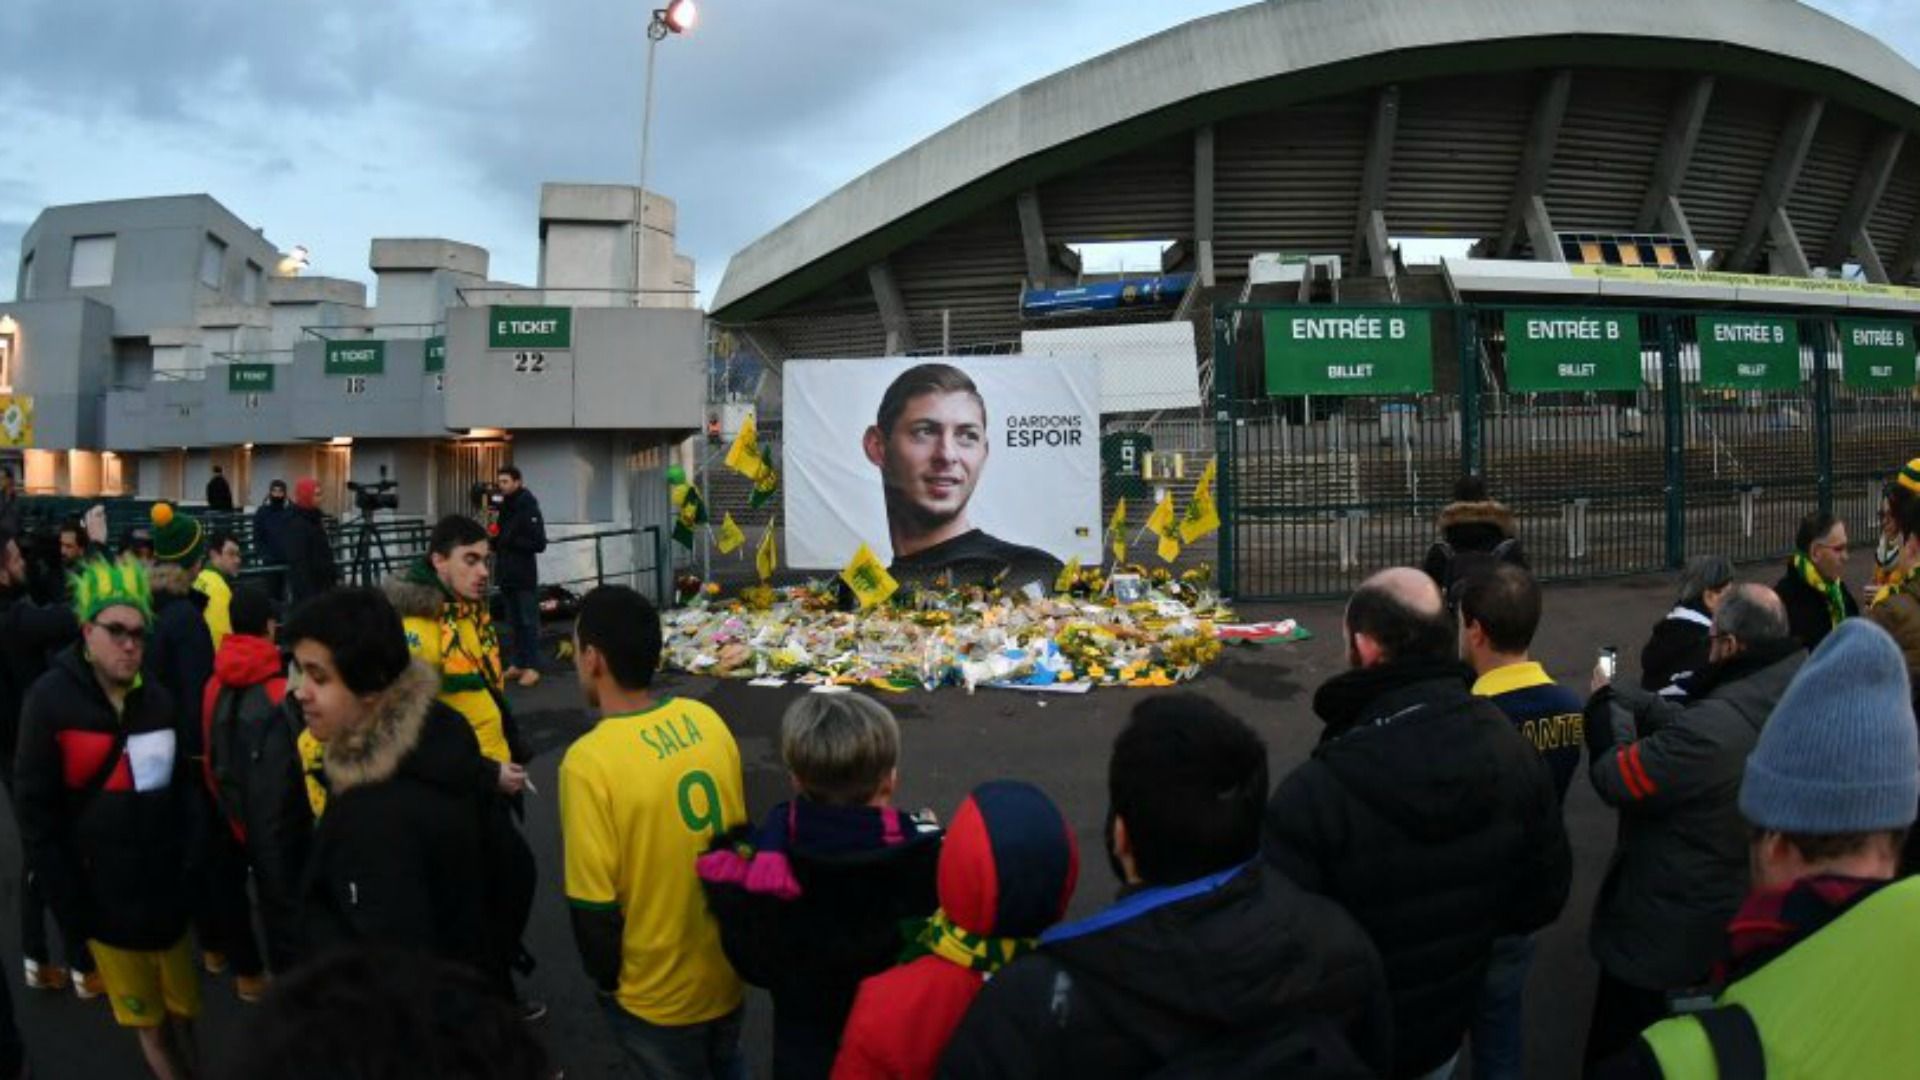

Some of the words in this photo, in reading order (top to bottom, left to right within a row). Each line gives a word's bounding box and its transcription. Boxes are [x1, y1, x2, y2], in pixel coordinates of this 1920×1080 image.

[498, 321, 507, 334] E
[510, 320, 557, 334] TICKET
[1292, 315, 1382, 339] ENTRÉE
[1389, 319, 1406, 339] B
[1527, 316, 1602, 339] ENTRÉE
[1606, 321, 1620, 339] B
[1714, 321, 1770, 343] ENTRÉE
[1773, 325, 1784, 343] B
[1853, 328, 1895, 346] ENTRÉE
[1896, 330, 1904, 346] B
[515, 353, 544, 372] 22
[1328, 363, 1374, 378] BILLET
[1558, 363, 1596, 376] BILLET
[1006, 415, 1082, 428] GARDONS
[1006, 430, 1082, 447] ESPOIR
[1121, 446, 1135, 471] 9
[640, 713, 703, 759] SALA
[1522, 712, 1583, 751] ANTE
[678, 770, 723, 834] 9
